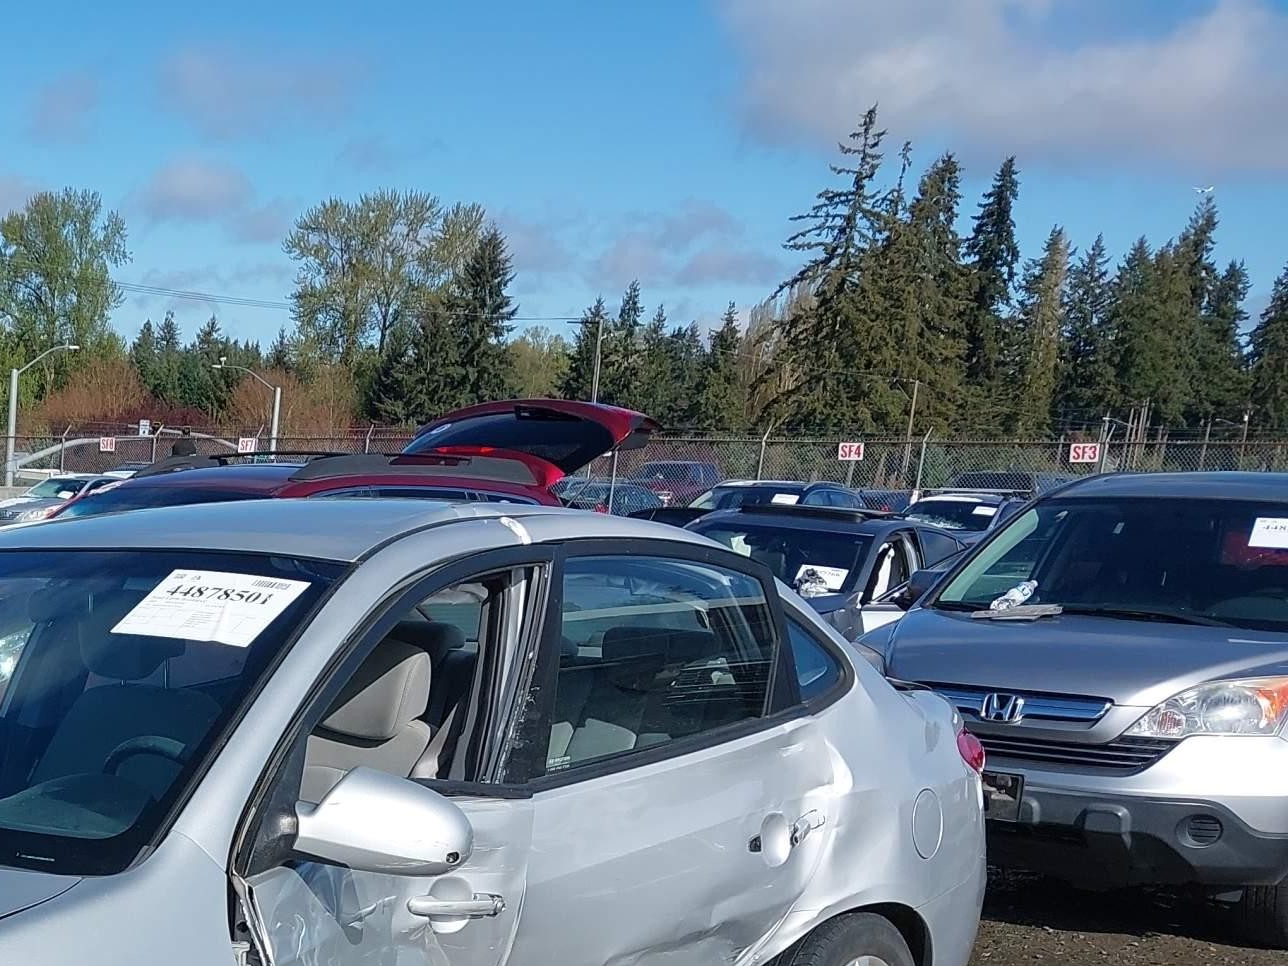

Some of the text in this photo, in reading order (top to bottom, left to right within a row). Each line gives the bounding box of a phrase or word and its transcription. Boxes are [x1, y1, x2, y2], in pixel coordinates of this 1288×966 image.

[240, 440, 254, 451] SF7
[840, 444, 861, 458] SF4
[1072, 446, 1097, 460] SF3
[166, 584, 273, 606] 44878501
